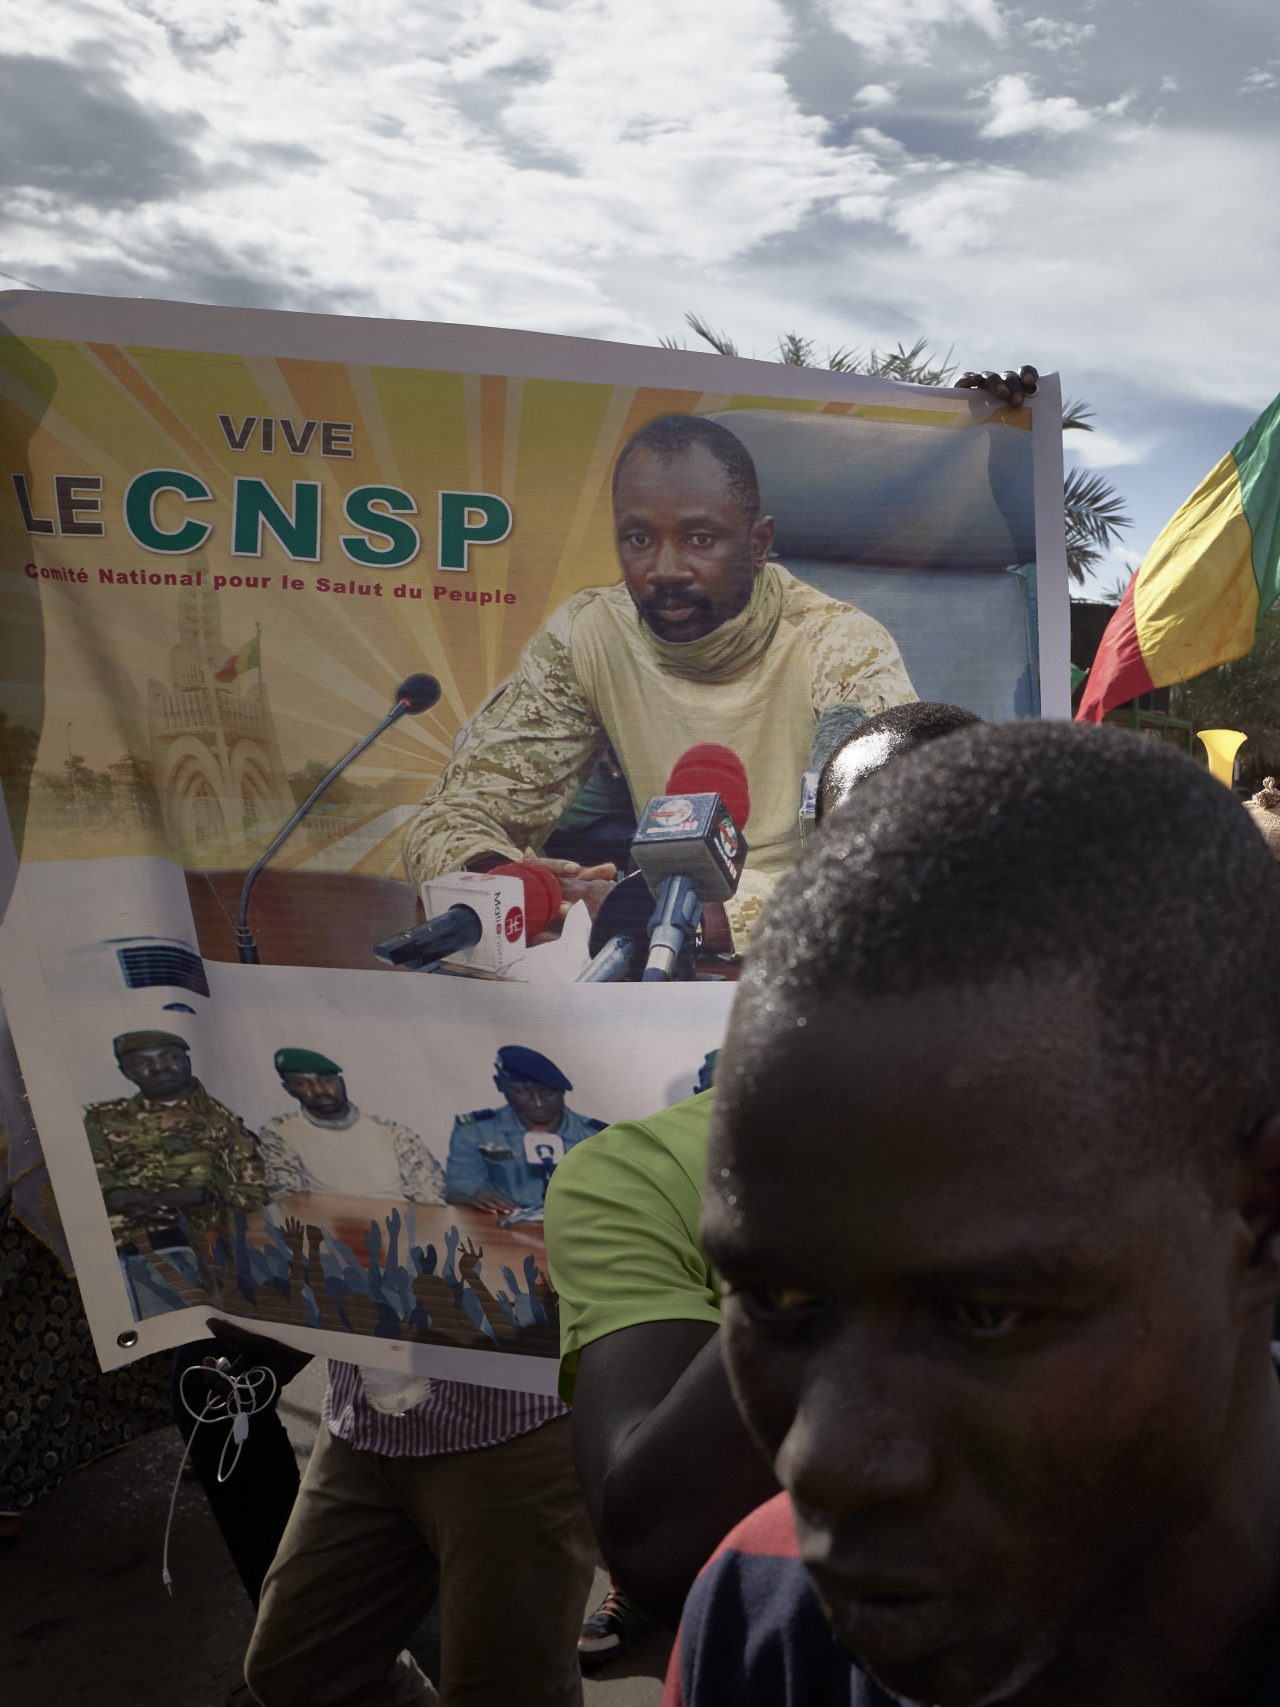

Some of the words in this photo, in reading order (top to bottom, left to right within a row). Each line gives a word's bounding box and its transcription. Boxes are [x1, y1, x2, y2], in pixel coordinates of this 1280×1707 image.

[216, 413, 354, 458] VIVE
[10, 473, 105, 538] LE
[123, 467, 513, 572] CNSP
[25, 563, 89, 583] Comité
[99, 568, 202, 587] National
[213, 574, 272, 590] pour
[282, 575, 305, 591] le
[316, 577, 383, 597] Salut
[393, 584, 423, 599] du
[434, 586, 517, 606] Peuple
